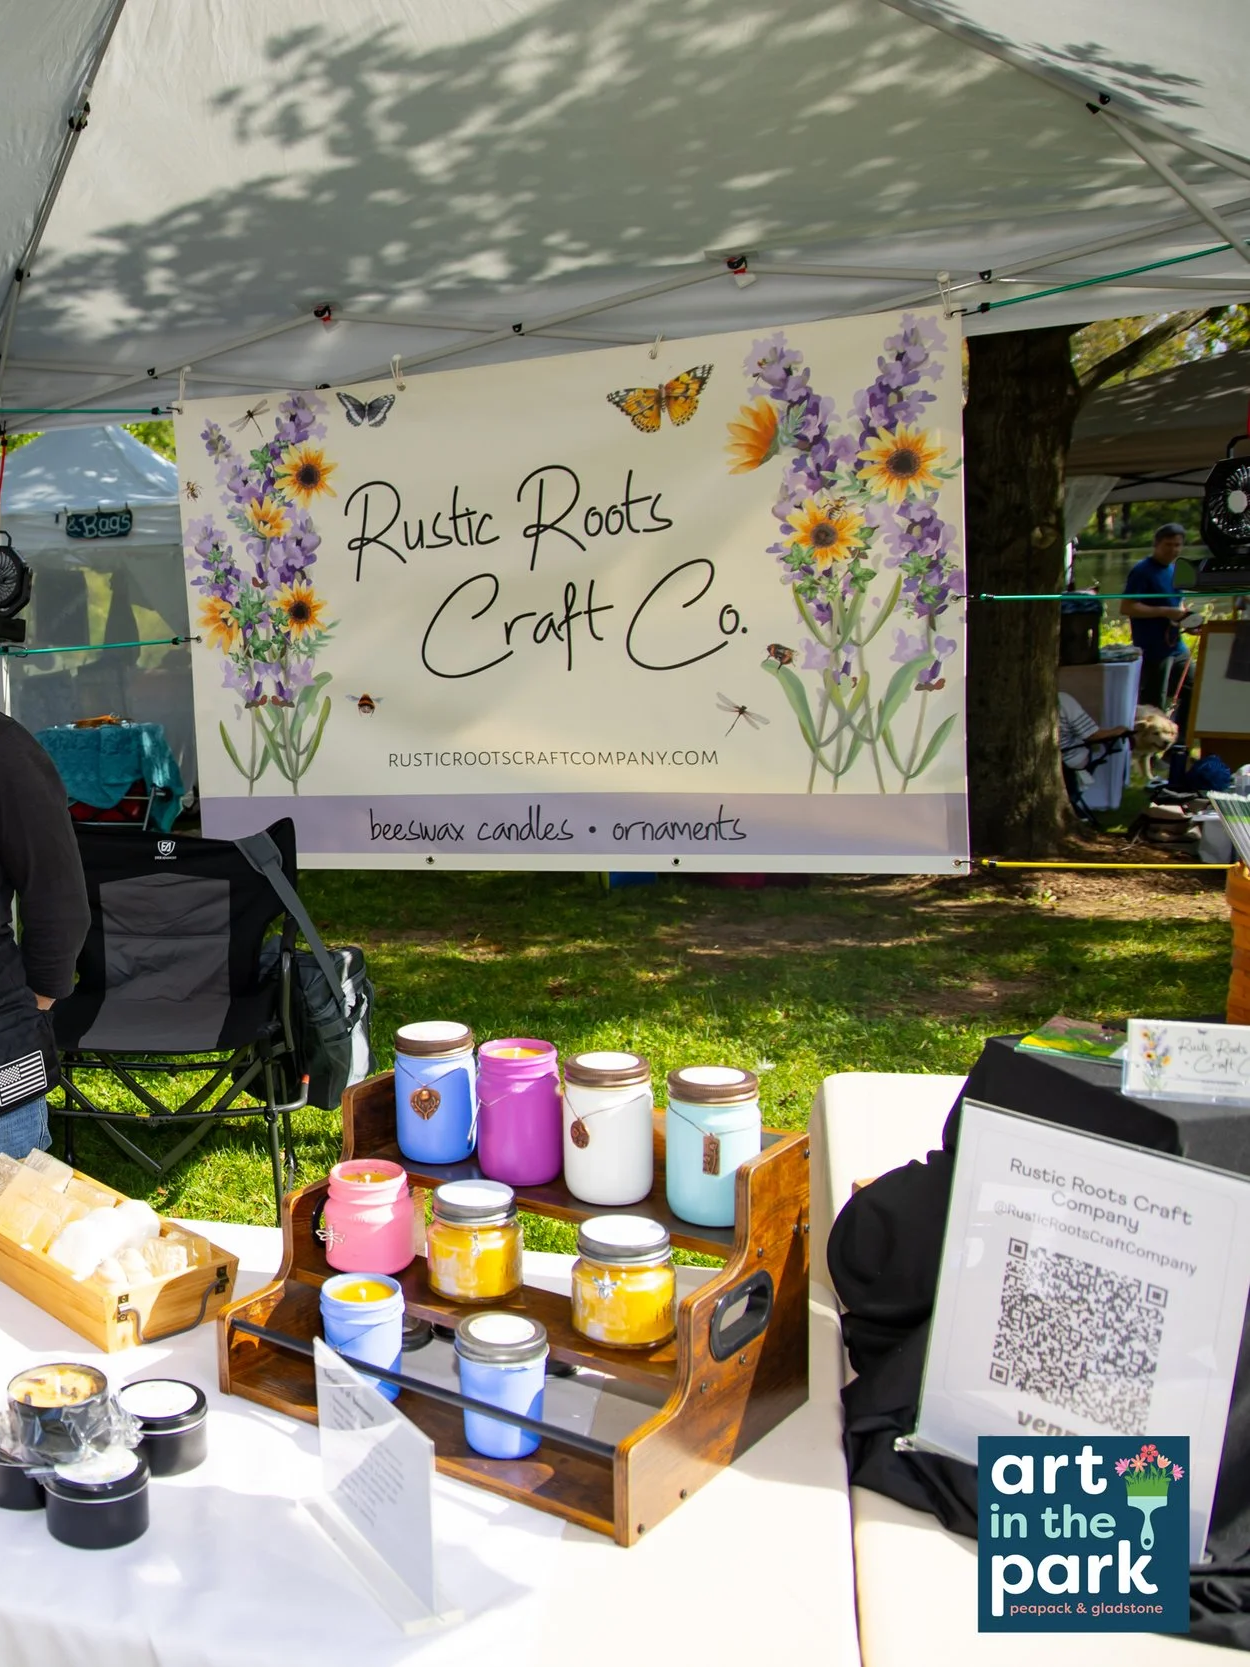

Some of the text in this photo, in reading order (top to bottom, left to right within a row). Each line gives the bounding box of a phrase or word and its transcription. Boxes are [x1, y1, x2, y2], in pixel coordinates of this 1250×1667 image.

[67, 514, 131, 538] & Bags
[344, 464, 673, 582] Rustic Roots
[421, 558, 748, 678] Craft Co.
[388, 750, 719, 768] RUSTICROOTSCRAFTCOMPANY.COM
[369, 804, 748, 842] beeswax candles ornaments
[1009, 1157, 1194, 1227] Rustic Roots Craft
[1051, 1190, 1140, 1235] Company
[993, 1200, 1198, 1278] @RusticRootsCraftCompany
